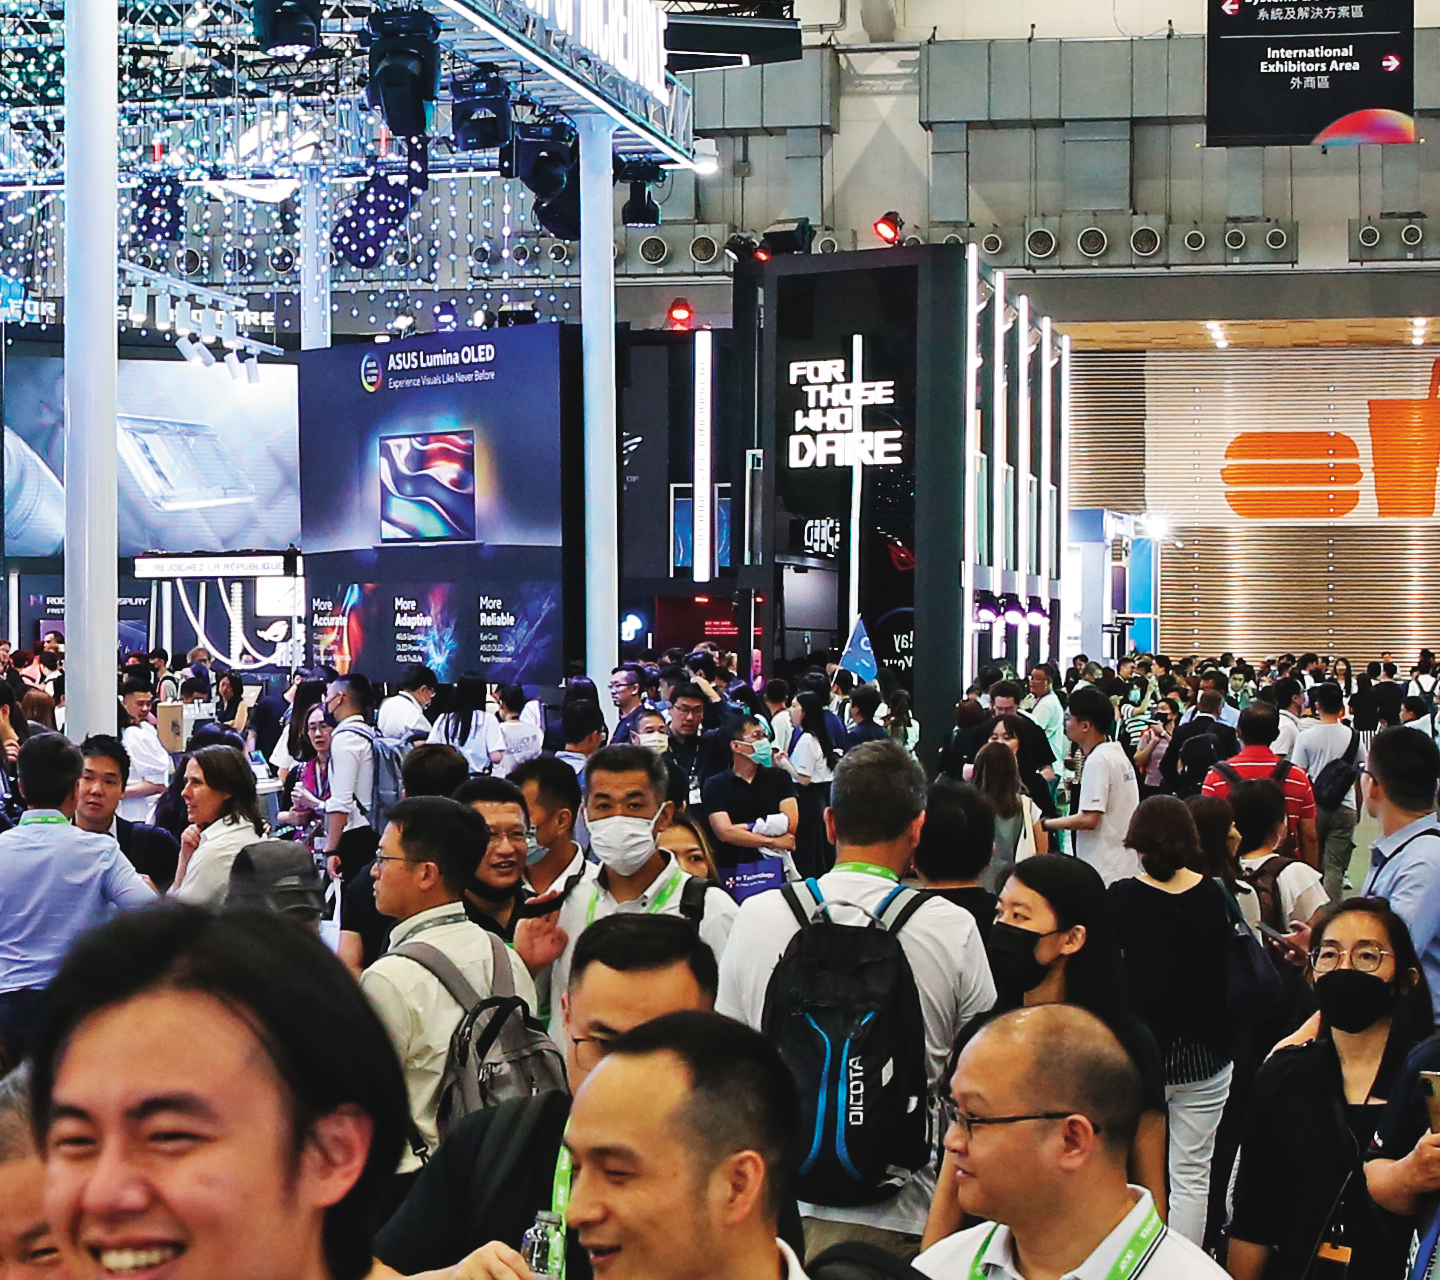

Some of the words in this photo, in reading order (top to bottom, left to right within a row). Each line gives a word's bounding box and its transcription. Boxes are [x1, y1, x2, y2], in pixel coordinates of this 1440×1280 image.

[1257, 5, 1364, 21] 系統及解決方案區
[1267, 45, 1353, 59] International
[1260, 60, 1327, 73] Exhibitors
[1329, 59, 1360, 71] Area
[1290, 75, 1330, 89] 外商區
[387, 351, 418, 371] ASUS
[420, 349, 460, 368] Lumina
[461, 344, 496, 364] OLED
[788, 359, 845, 385] FOR
[801, 380, 895, 408] THOSE
[794, 407, 852, 432] WHO
[788, 430, 904, 468] DARE
[312, 597, 333, 611] More
[394, 596, 416, 611] More
[479, 595, 502, 610] More
[312, 613, 348, 627] Accurate
[394, 612, 433, 629] Adaptive
[479, 612, 515, 627] Reliable
[849, 1055, 865, 1127] DICOTA
